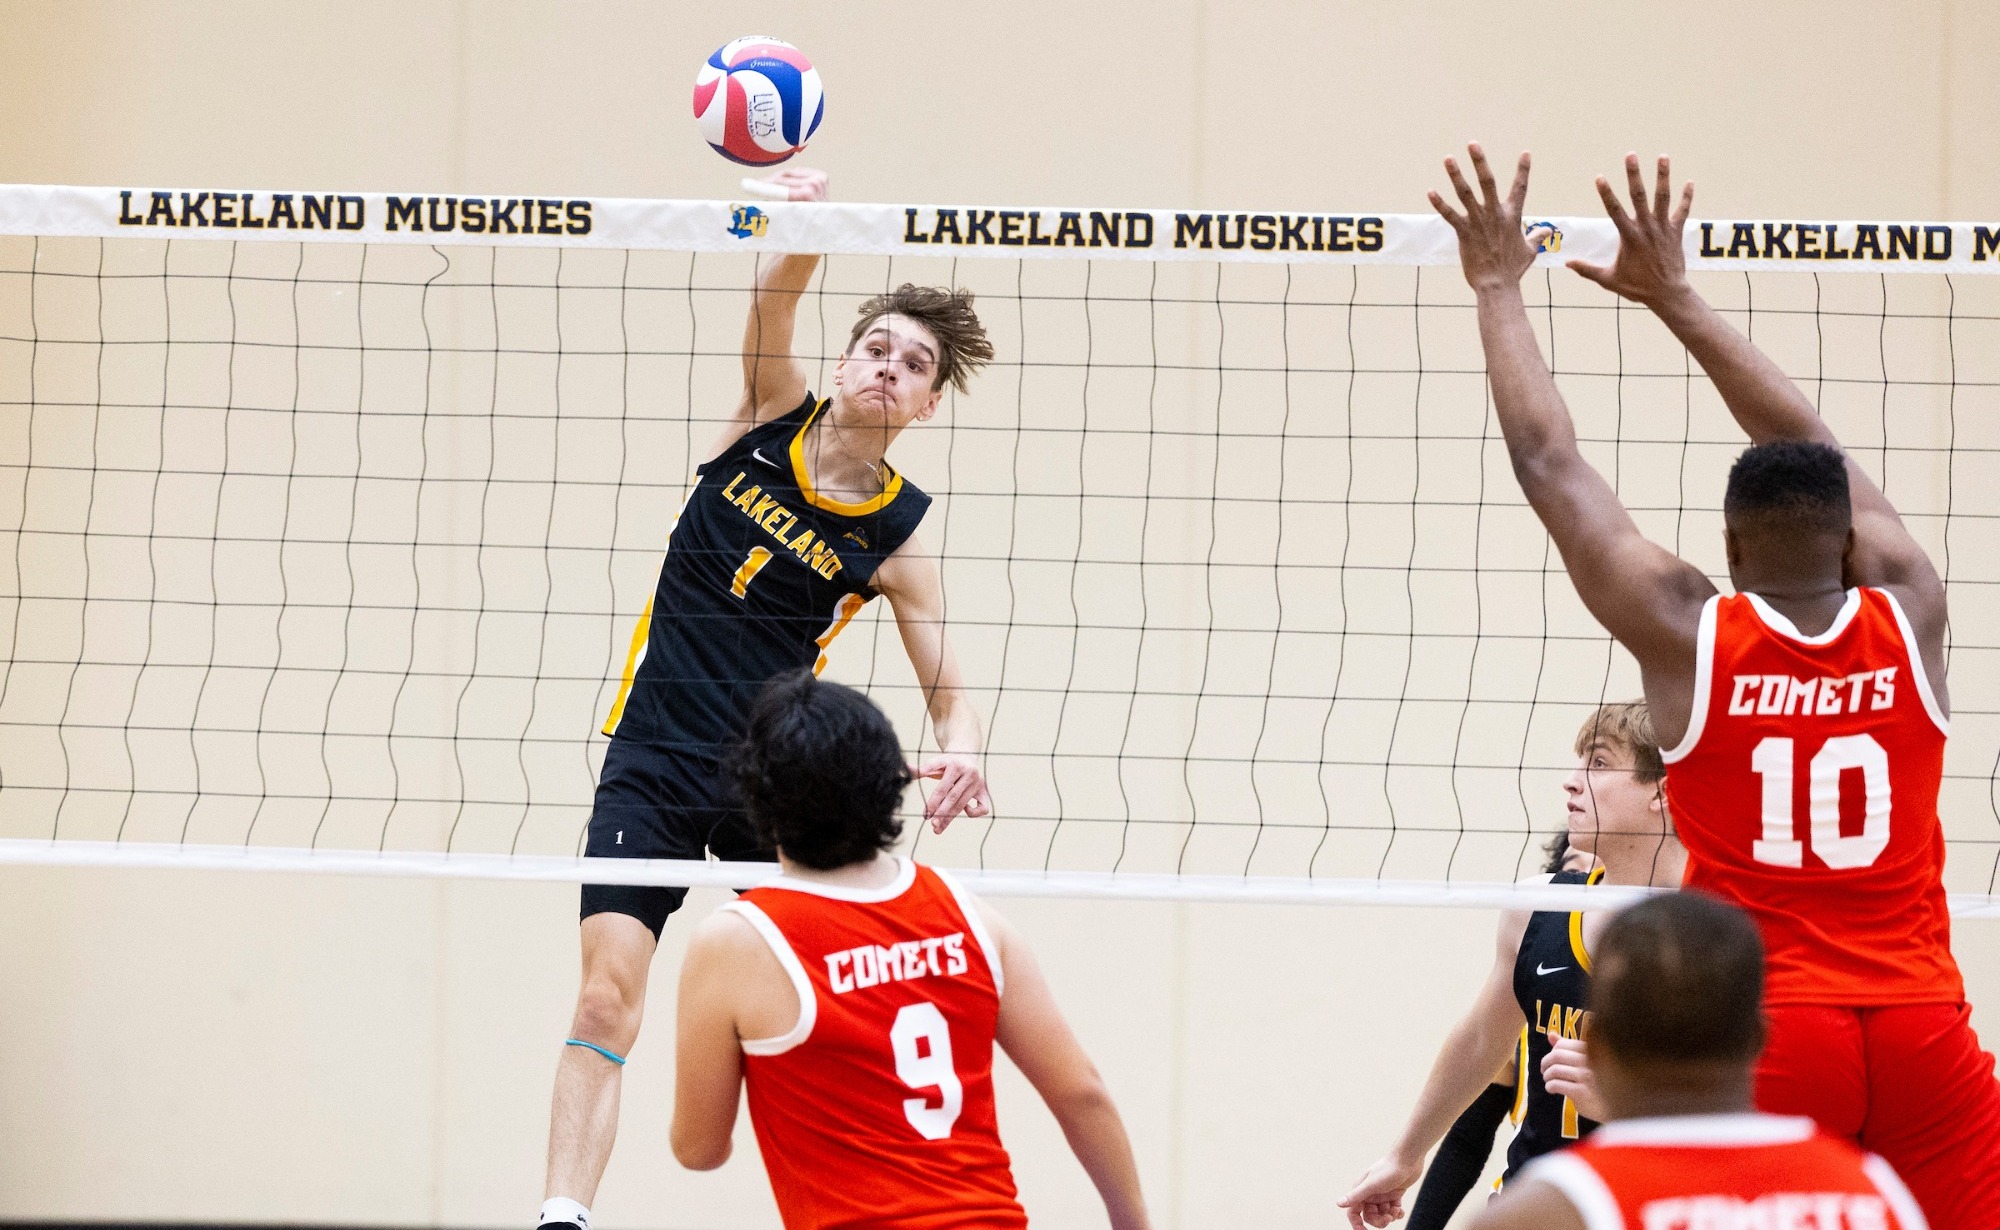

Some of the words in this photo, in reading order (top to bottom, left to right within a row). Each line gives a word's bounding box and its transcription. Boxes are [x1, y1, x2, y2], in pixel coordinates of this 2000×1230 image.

[118, 190, 365, 231] LAKELAND
[385, 196, 593, 236] MUSKIES
[904, 208, 1154, 248] LAKELAND
[1174, 213, 1384, 252] MUSKIES
[1700, 222, 1953, 262] LAKELAND
[722, 471, 843, 581] LAKELAND
[730, 545, 774, 600] 1
[1727, 666, 1899, 716] COMETS
[1751, 733, 1892, 870] 10
[615, 830, 624, 845] 1
[823, 931, 968, 995] COMETS
[889, 1001, 963, 1141] 9
